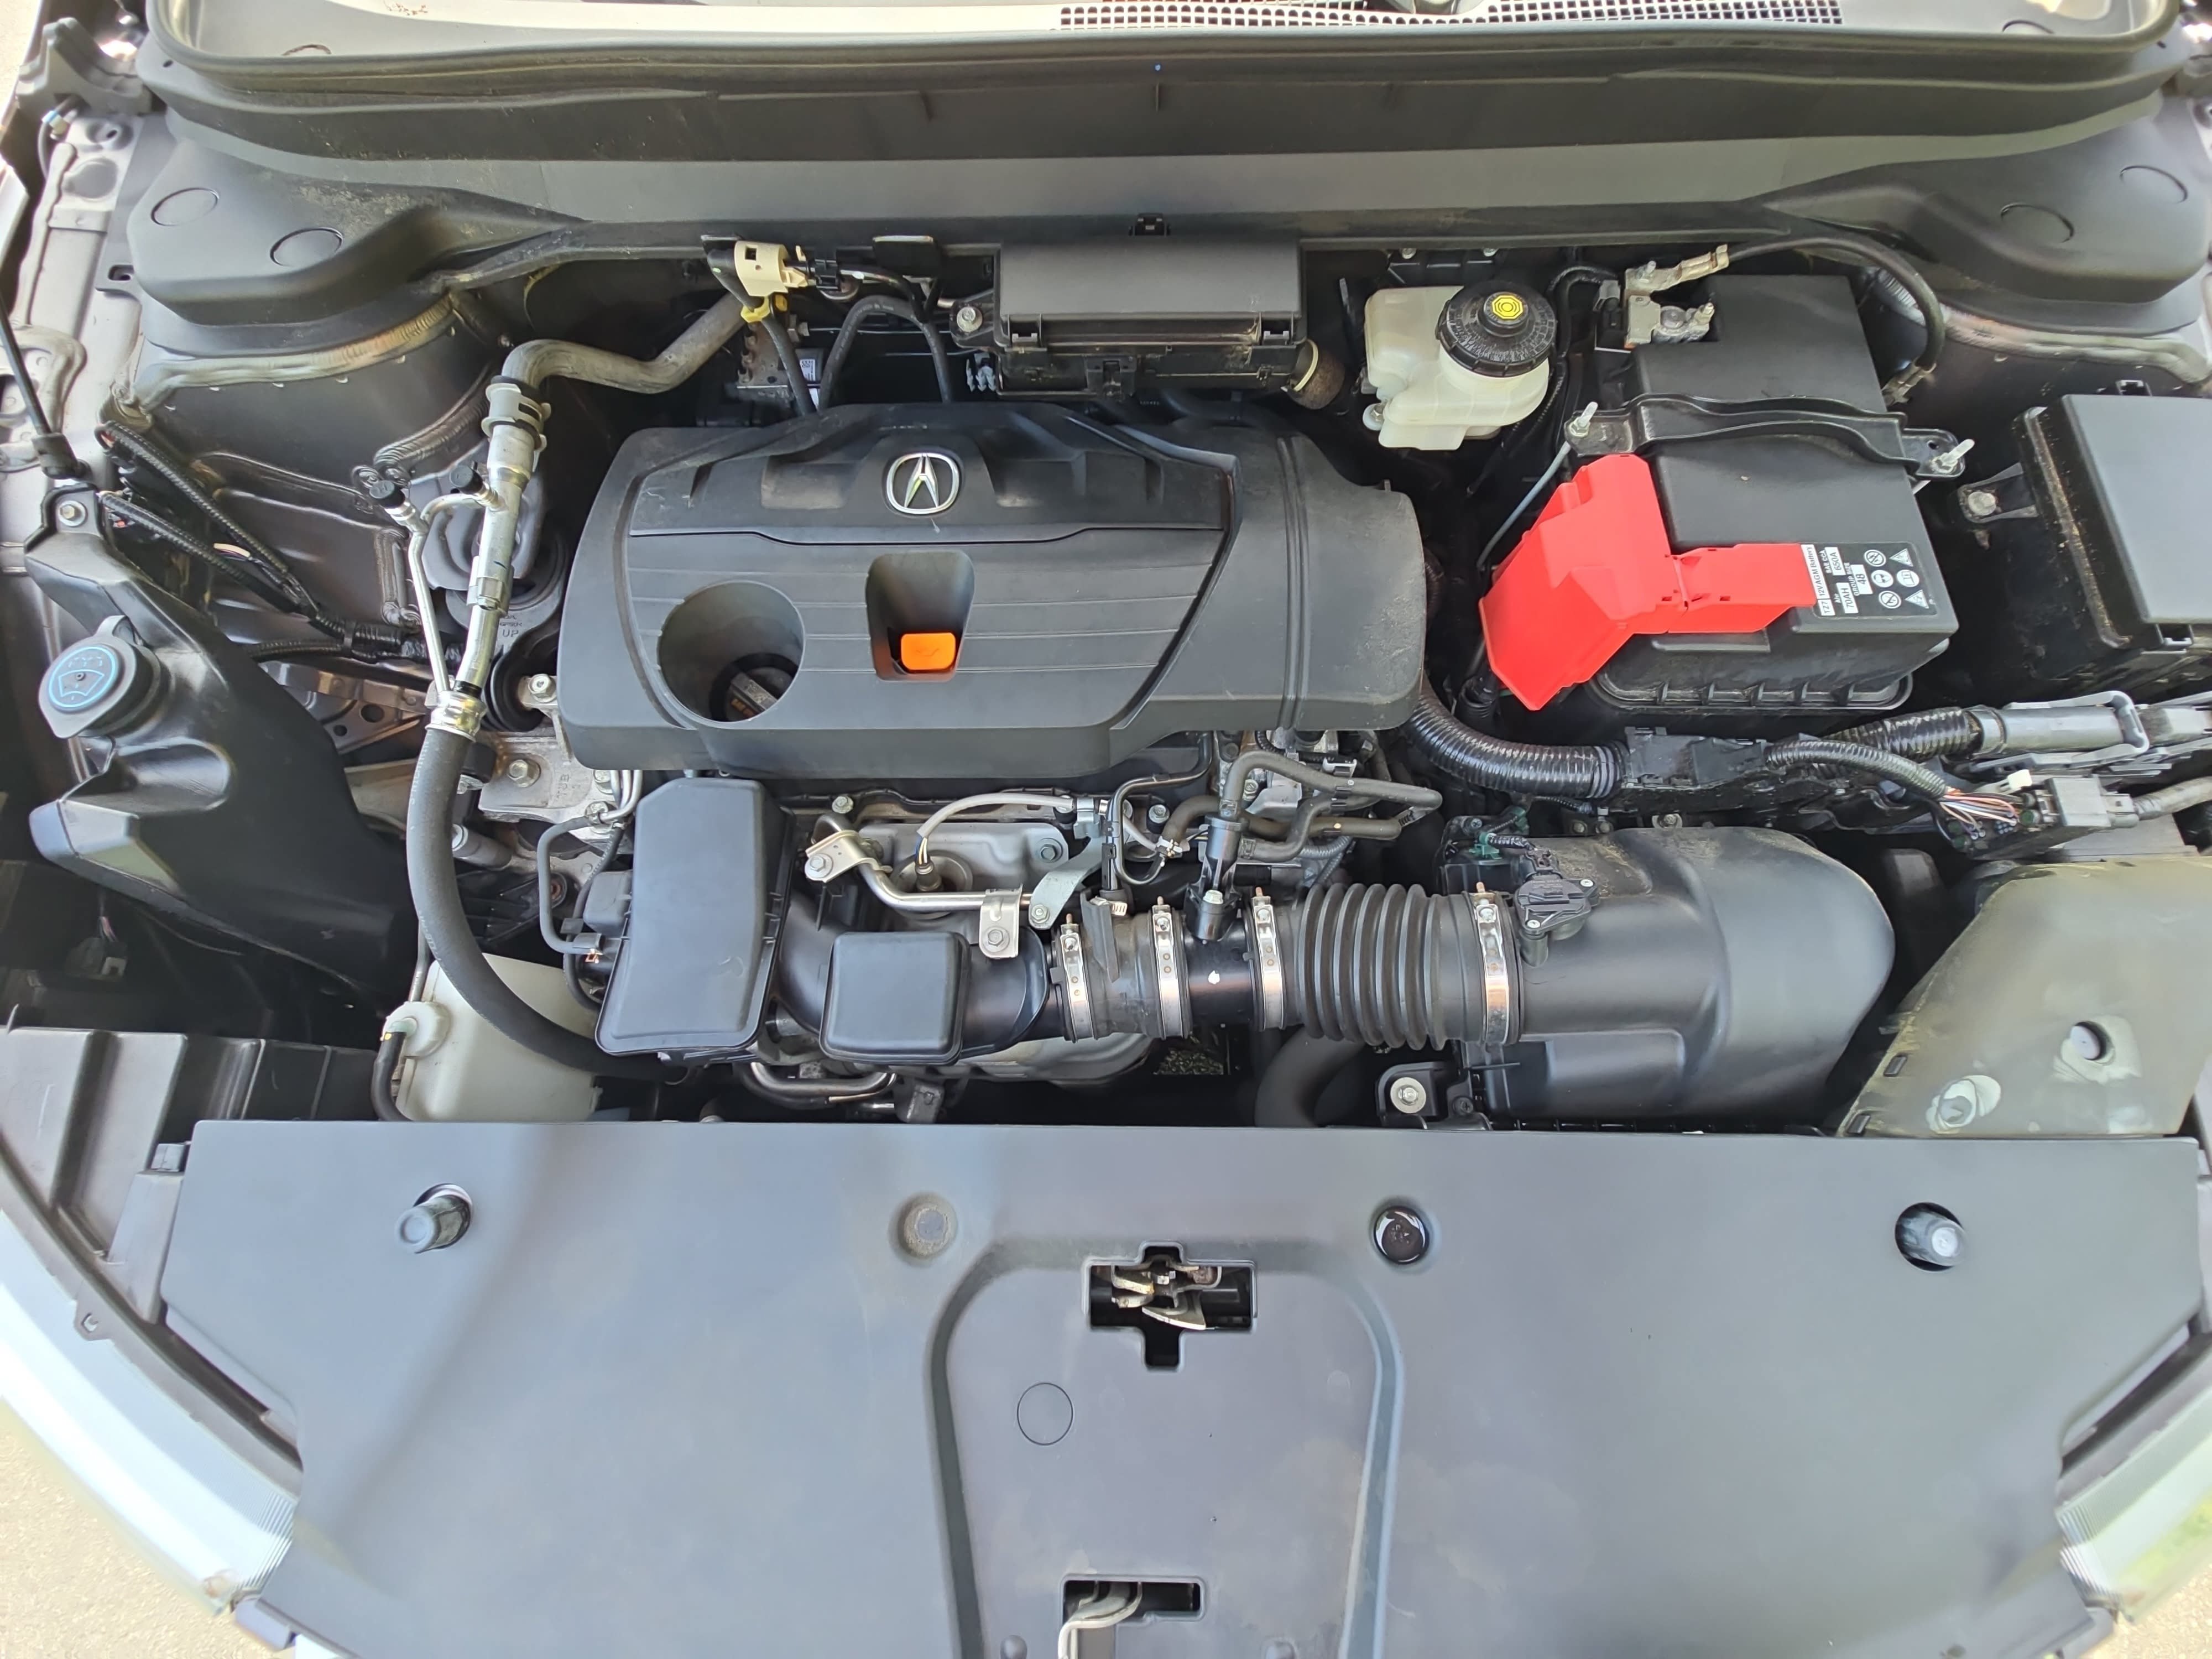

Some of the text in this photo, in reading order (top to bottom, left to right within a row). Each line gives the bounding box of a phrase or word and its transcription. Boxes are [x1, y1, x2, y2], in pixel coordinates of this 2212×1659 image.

[1806, 546, 1817, 568] Battery
[1829, 552, 1841, 570] 650A
[1848, 576, 1859, 596] GROUP
[1855, 573, 1866, 585] 48
[1840, 588, 1854, 608] 70AH
